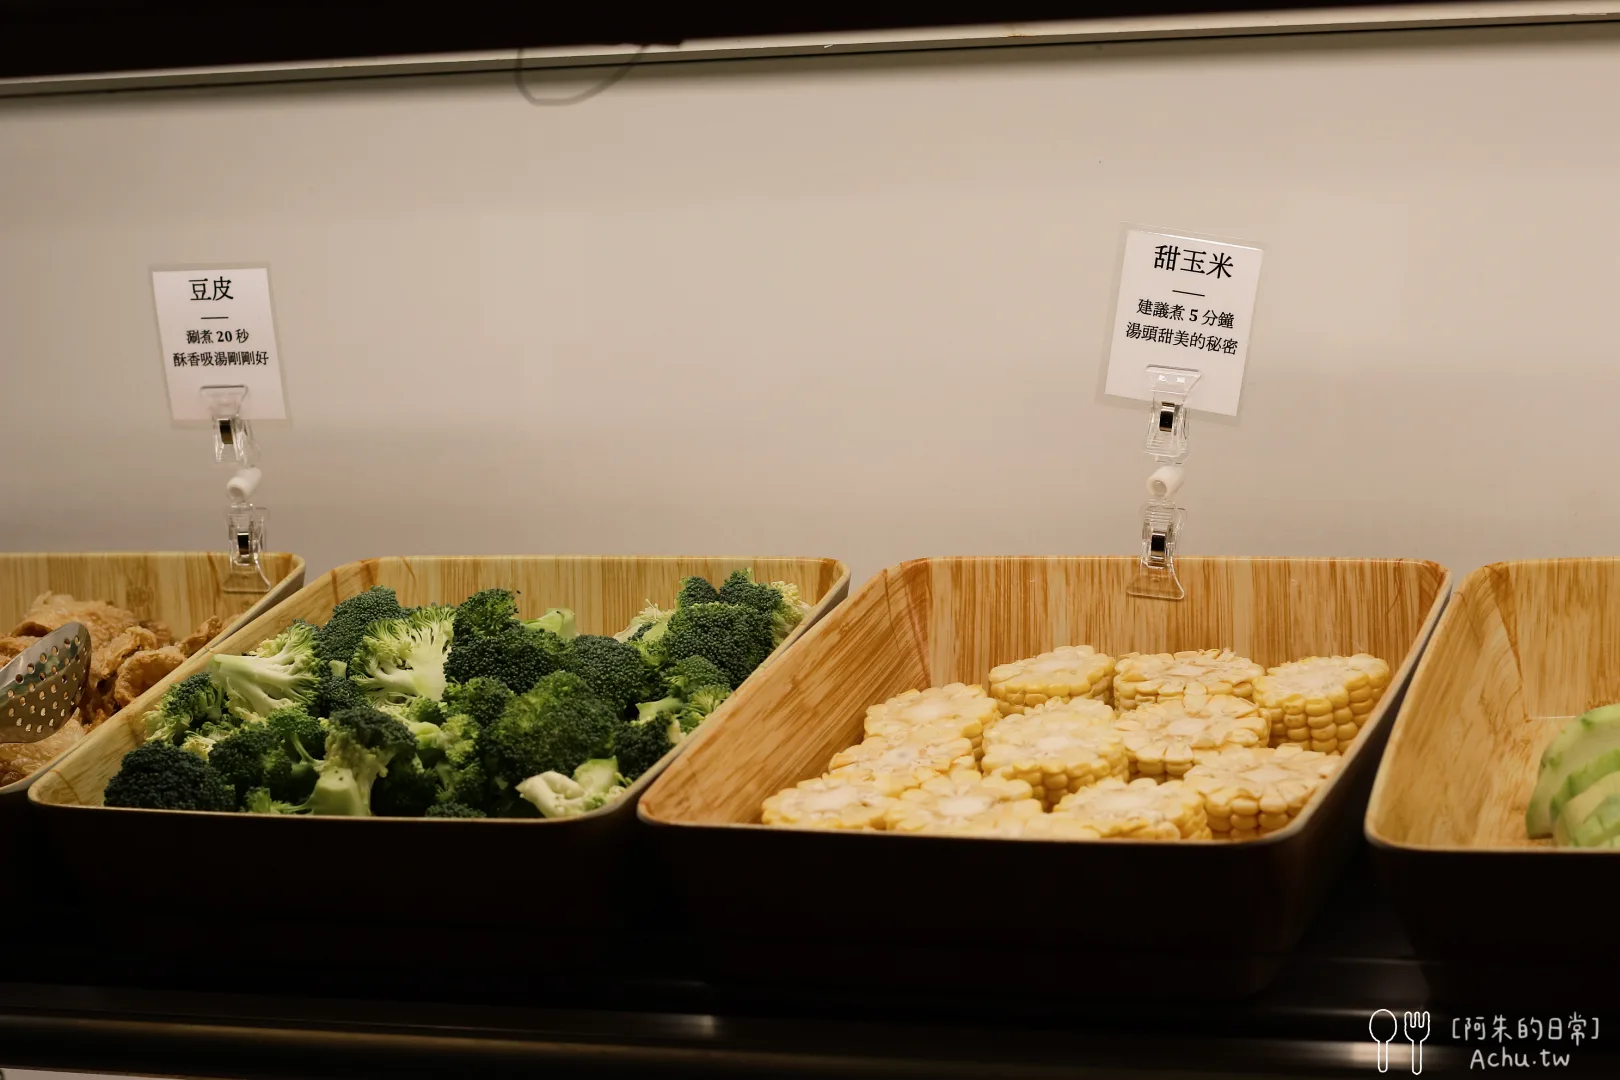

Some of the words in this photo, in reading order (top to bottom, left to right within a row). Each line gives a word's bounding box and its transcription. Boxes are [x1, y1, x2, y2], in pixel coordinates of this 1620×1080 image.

[1153, 244, 1234, 279] 甜玉米
[188, 276, 234, 301] 豆皮
[1136, 298, 1185, 321] 建議煮
[1188, 309, 1199, 322] 5
[1201, 309, 1235, 329] 分鐘
[186, 329, 214, 344] 涮煮
[216, 330, 233, 343] 20
[235, 328, 250, 344] 秒
[1125, 321, 1239, 355] 湯頭甜美的秘密
[172, 350, 269, 367] 酥香吸湯剛剛好
